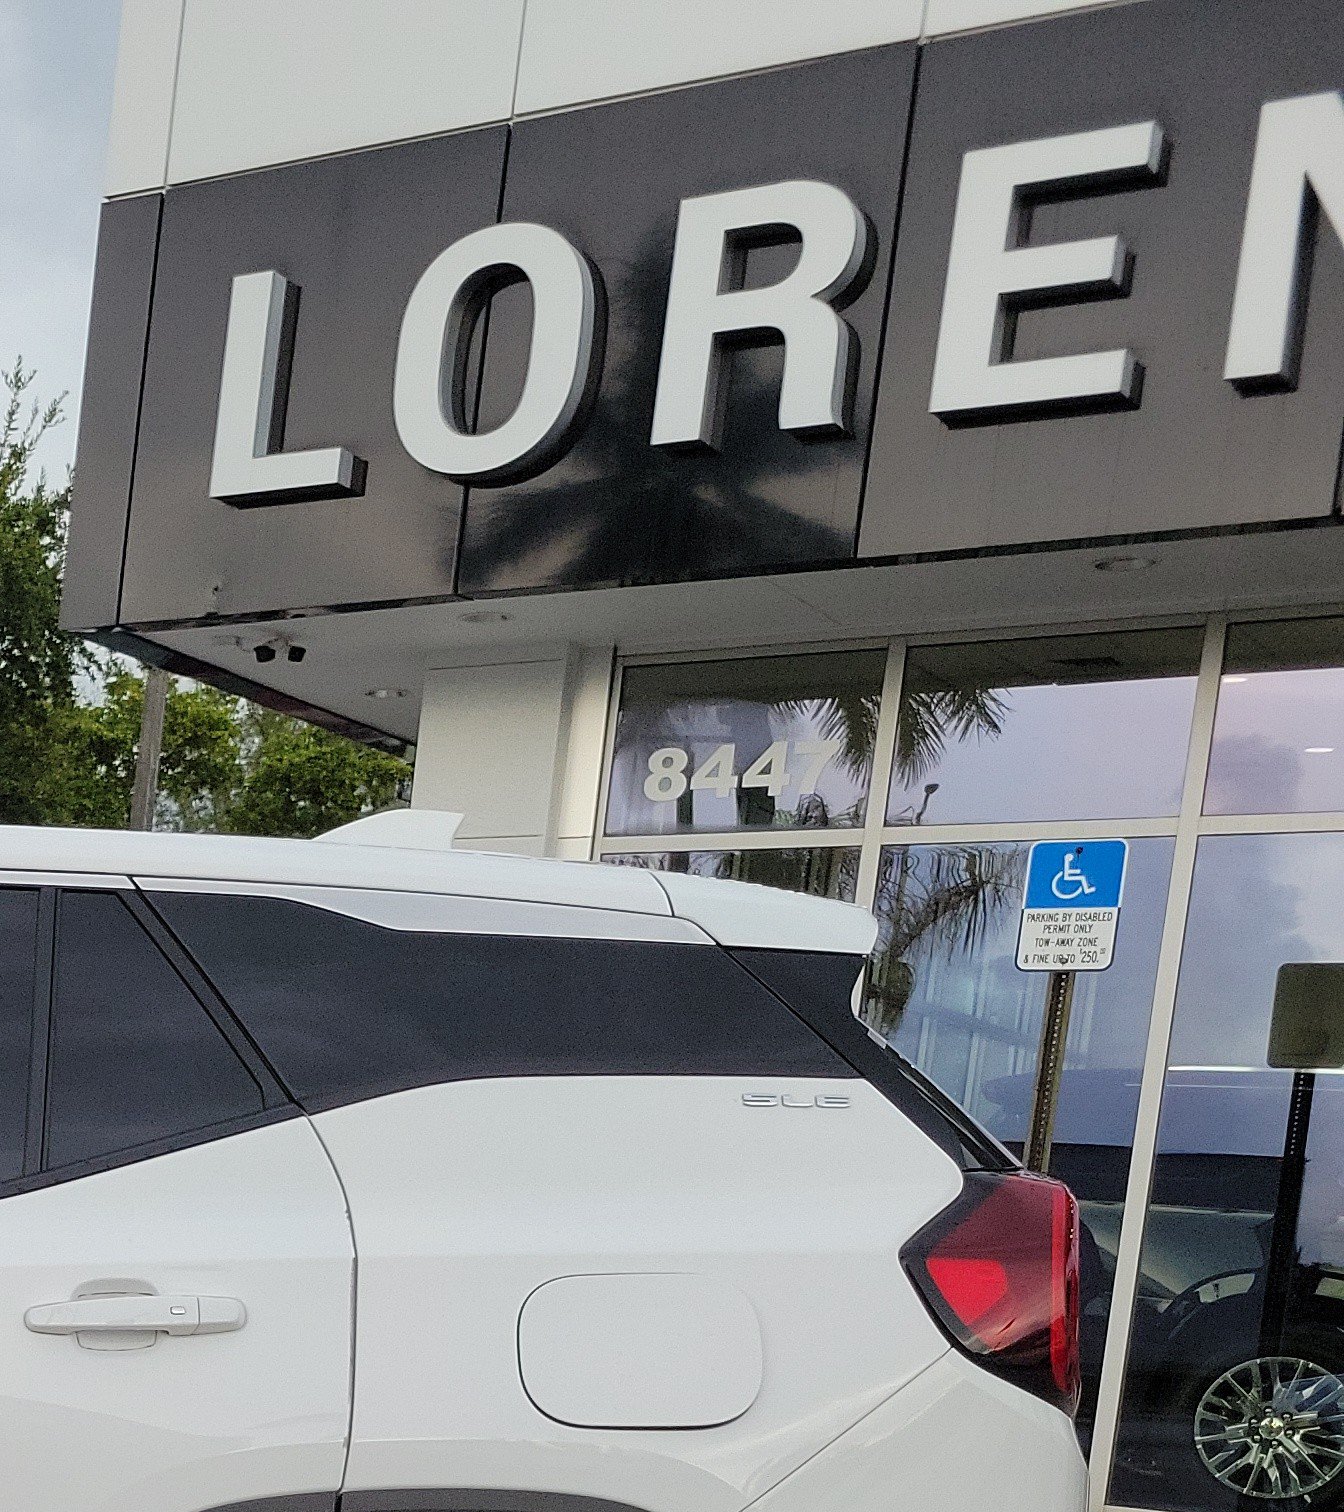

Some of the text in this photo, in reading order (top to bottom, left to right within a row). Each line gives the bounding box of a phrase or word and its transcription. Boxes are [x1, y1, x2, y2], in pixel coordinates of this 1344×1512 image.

[643, 738, 842, 802] 8447
[1026, 911, 1113, 923] PARKING BY DISABLED
[1042, 923, 1094, 934] PERMIT ONLY
[1035, 937, 1099, 948] TOW-AWAY ZONE
[1032, 953, 1050, 964] FINE
[741, 1092, 851, 1109] SLE
